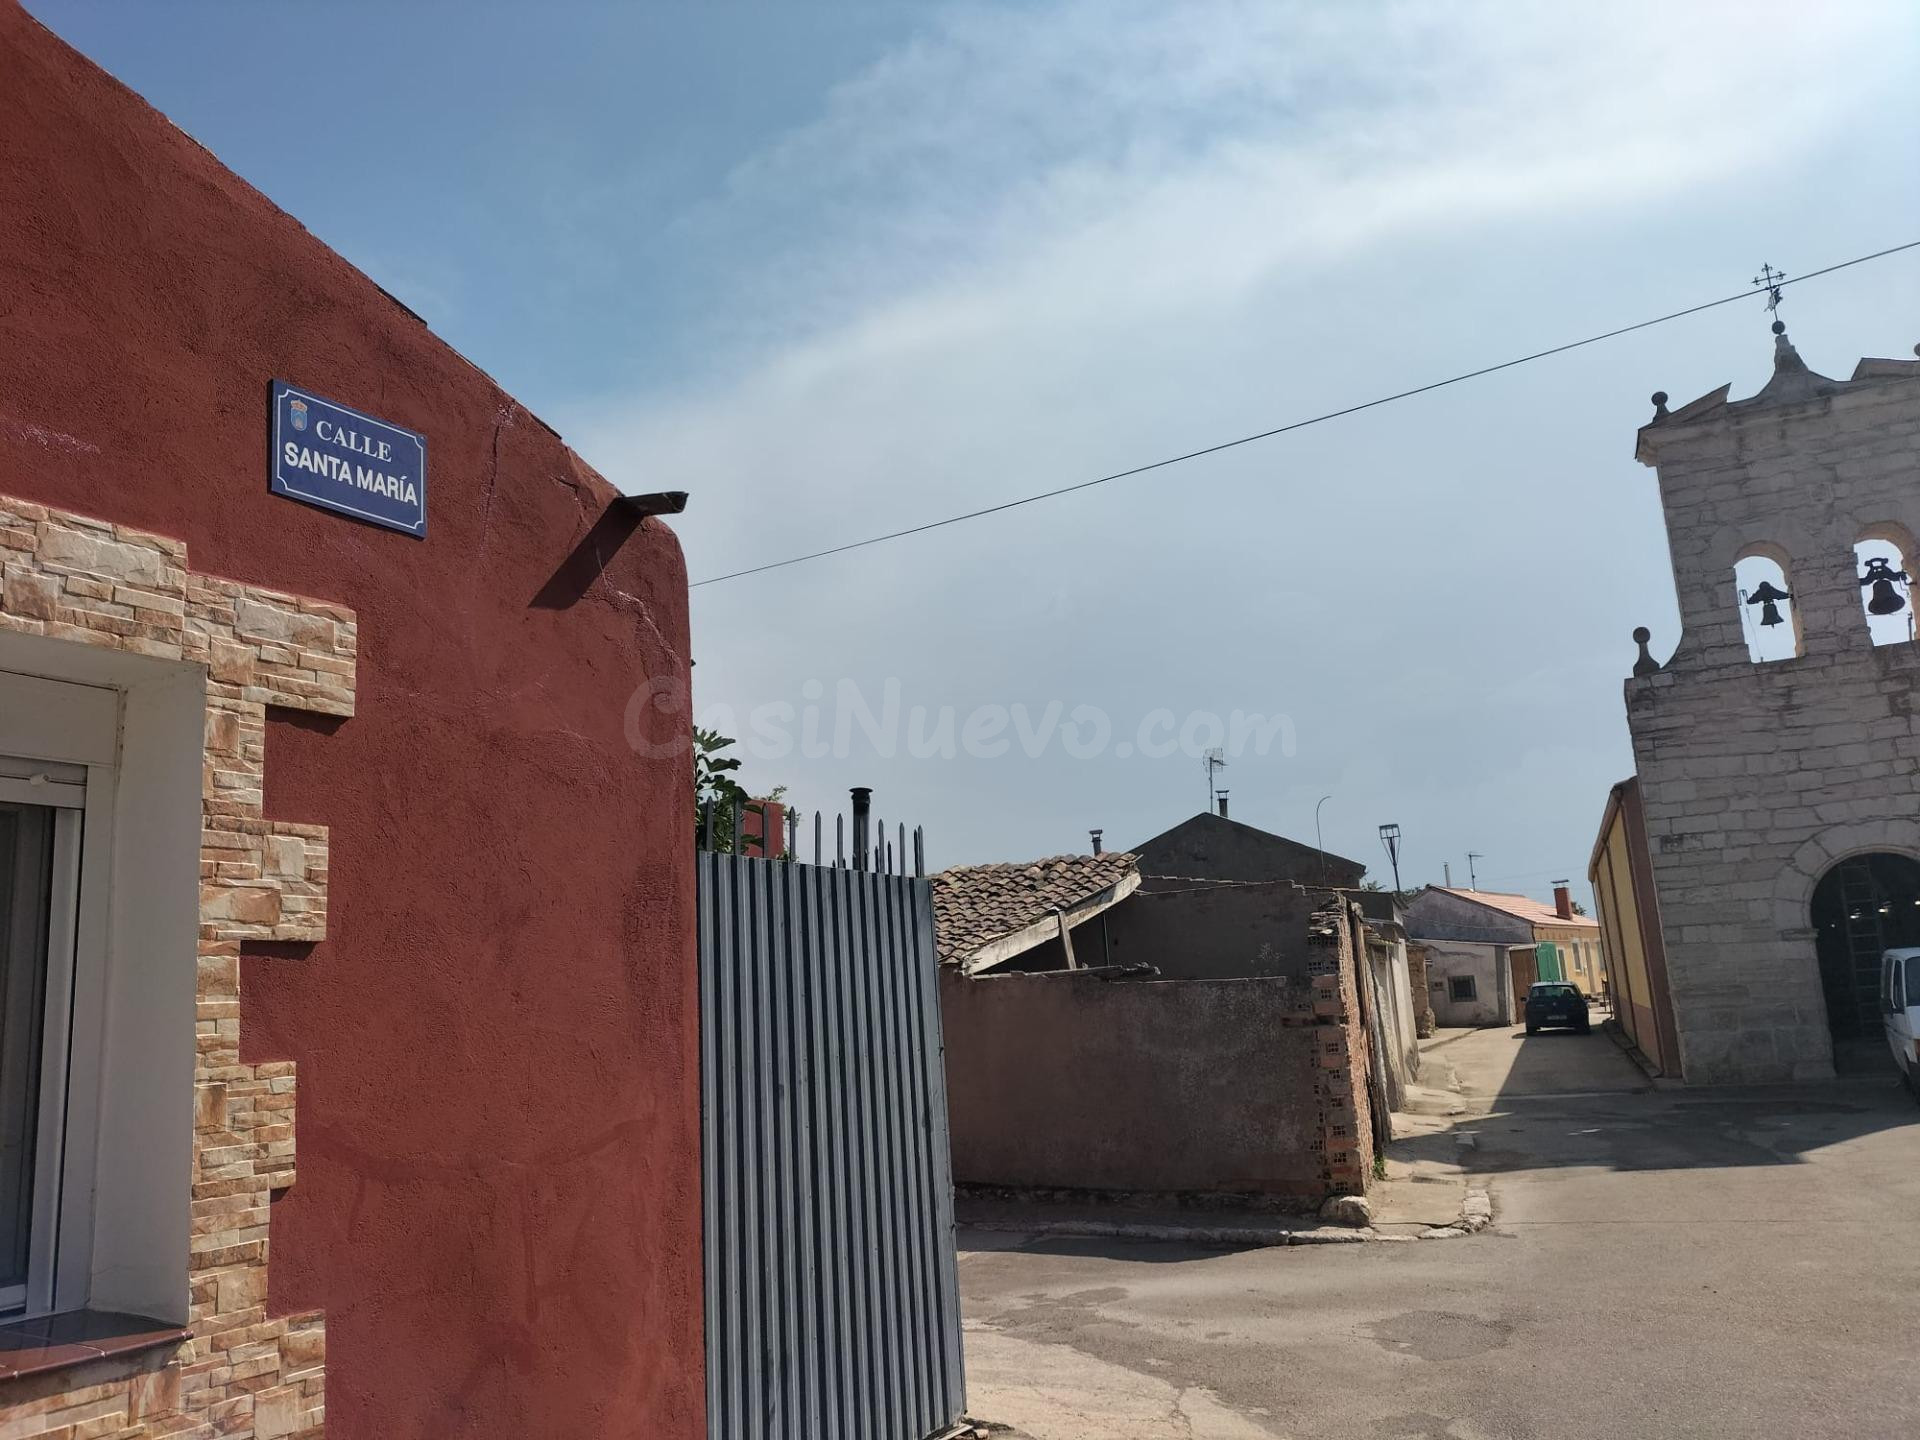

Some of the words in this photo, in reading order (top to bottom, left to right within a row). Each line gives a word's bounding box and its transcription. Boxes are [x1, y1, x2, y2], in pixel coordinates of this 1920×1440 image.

[316, 421, 392, 462] CALLE
[284, 442, 353, 485] SANTA
[356, 465, 418, 506] MARÍA
